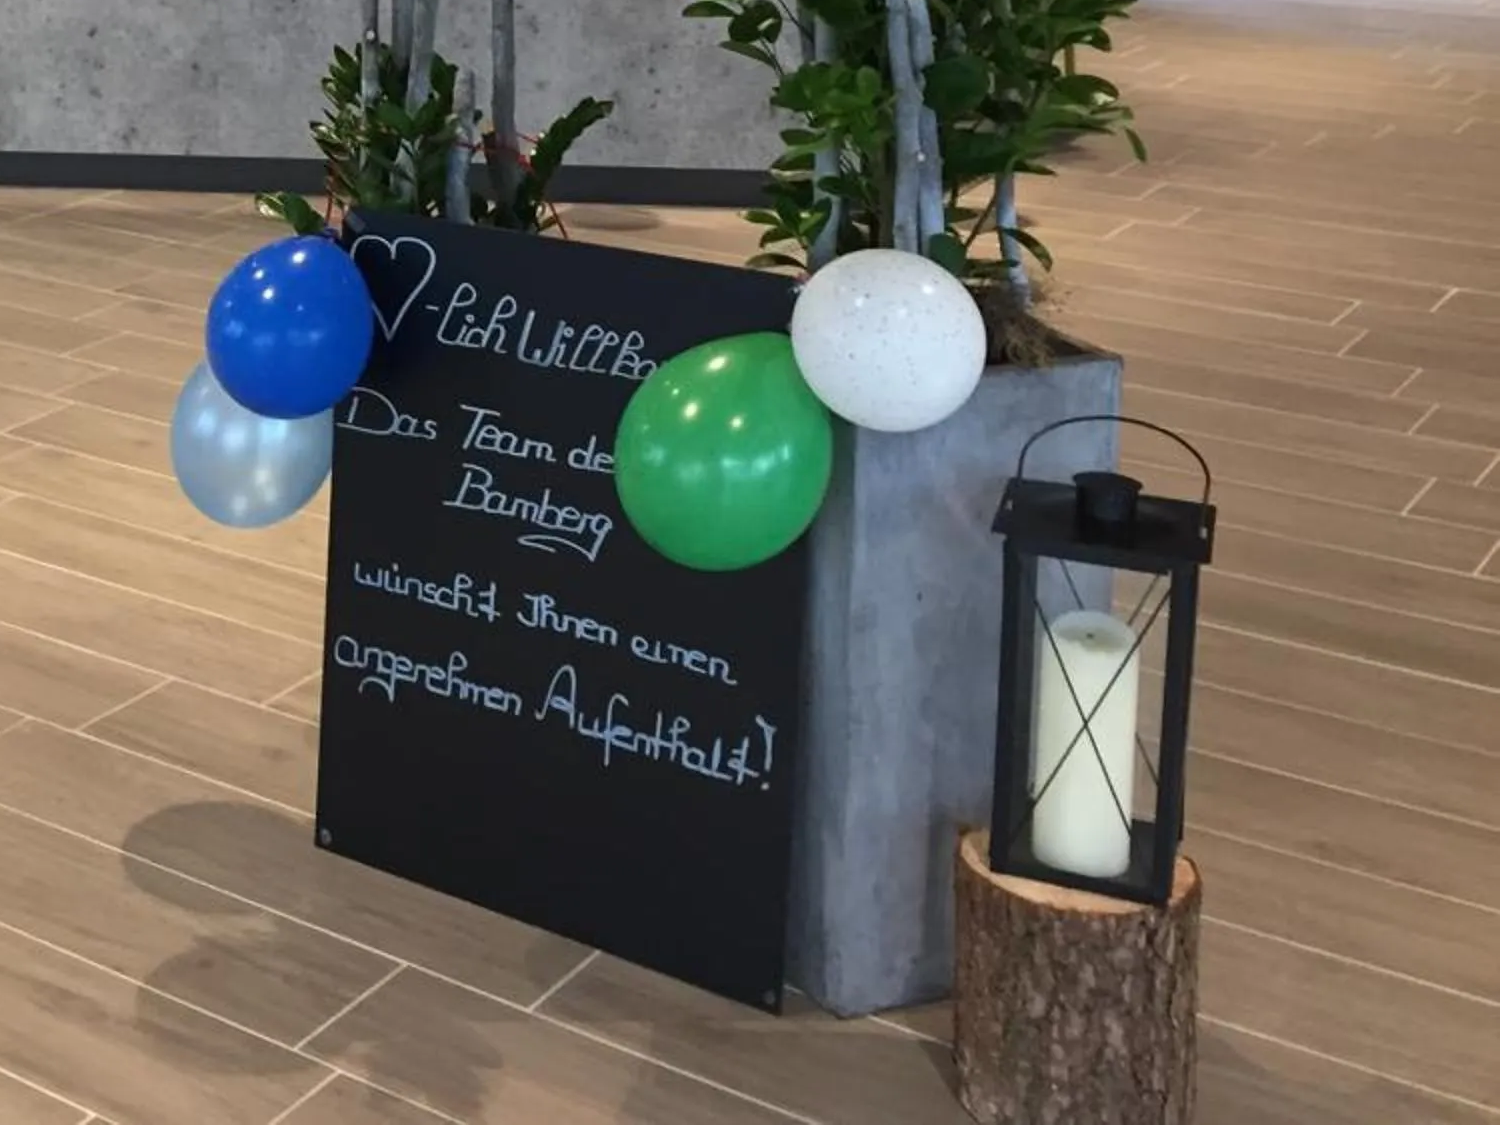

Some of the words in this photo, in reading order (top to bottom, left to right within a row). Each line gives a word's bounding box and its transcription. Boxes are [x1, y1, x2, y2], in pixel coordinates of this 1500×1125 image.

[516, 309, 657, 380] Willko
[336, 385, 438, 439] Das
[459, 403, 557, 462] Team
[567, 434, 618, 474] de
[442, 461, 613, 563] Bamberg
[631, 634, 738, 685] einen
[534, 663, 778, 791] Aufenthalt!
